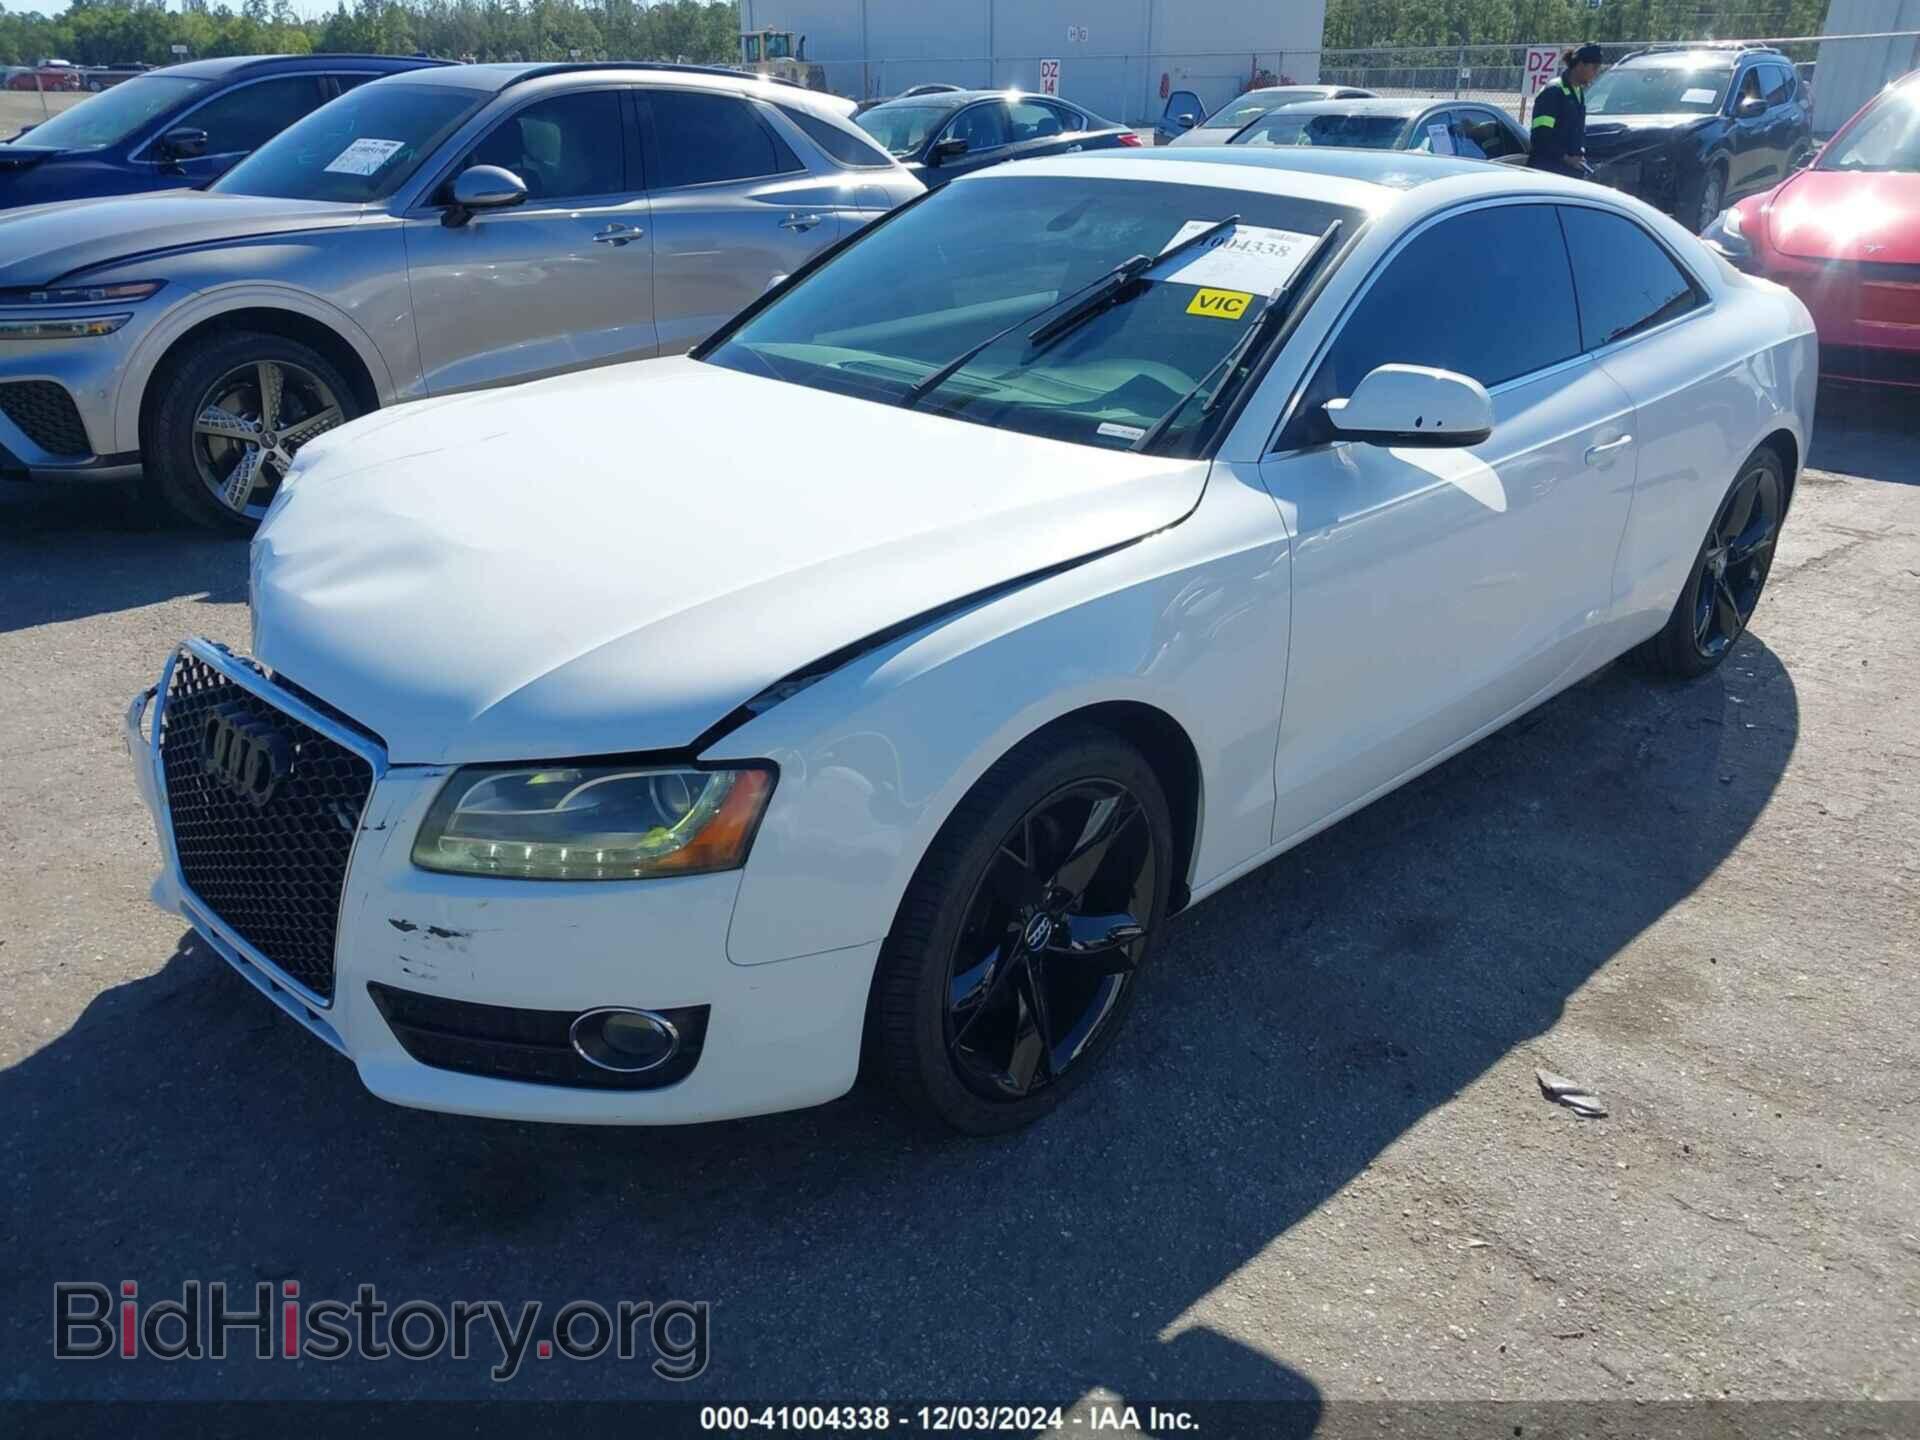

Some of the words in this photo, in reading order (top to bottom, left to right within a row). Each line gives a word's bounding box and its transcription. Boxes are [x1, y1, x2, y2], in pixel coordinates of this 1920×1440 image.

[1042, 62, 1058, 78] DZ
[1528, 52, 1557, 72] DZ
[1045, 80, 1055, 94] 14
[1196, 234, 1291, 257] 1004338
[1200, 295, 1243, 312] VIC
